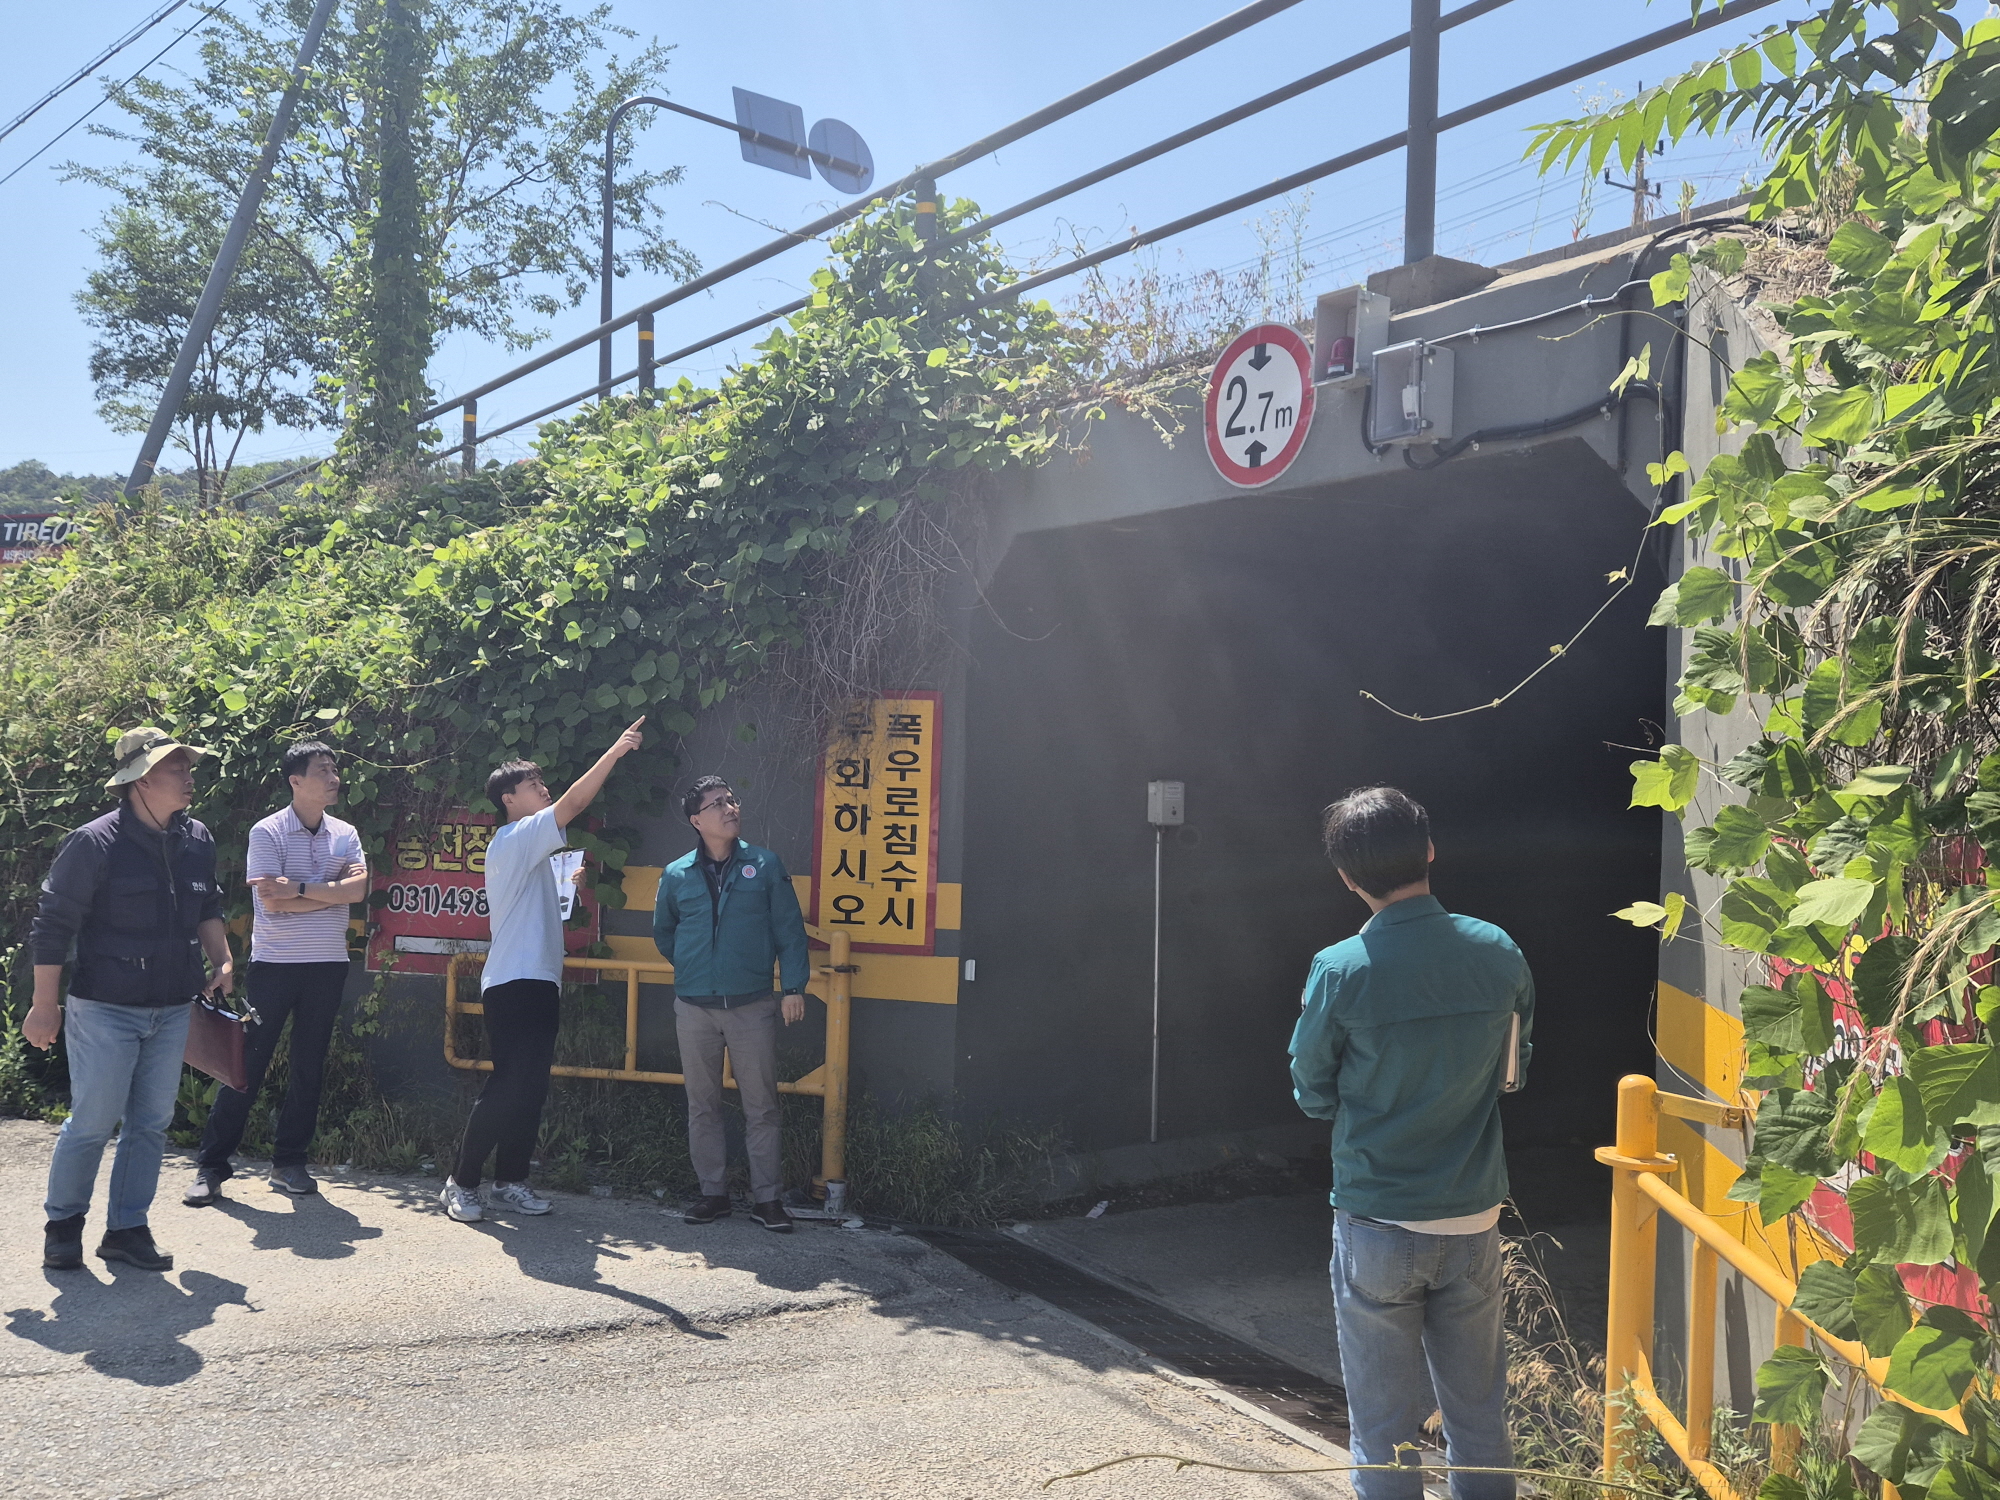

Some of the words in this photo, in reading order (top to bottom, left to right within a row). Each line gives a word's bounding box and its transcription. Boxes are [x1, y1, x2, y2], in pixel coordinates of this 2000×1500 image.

[1225, 375, 1293, 438] 2.7m
[878, 713, 922, 930] 폭우로침수시
[387, 883, 491, 917] 031)498
